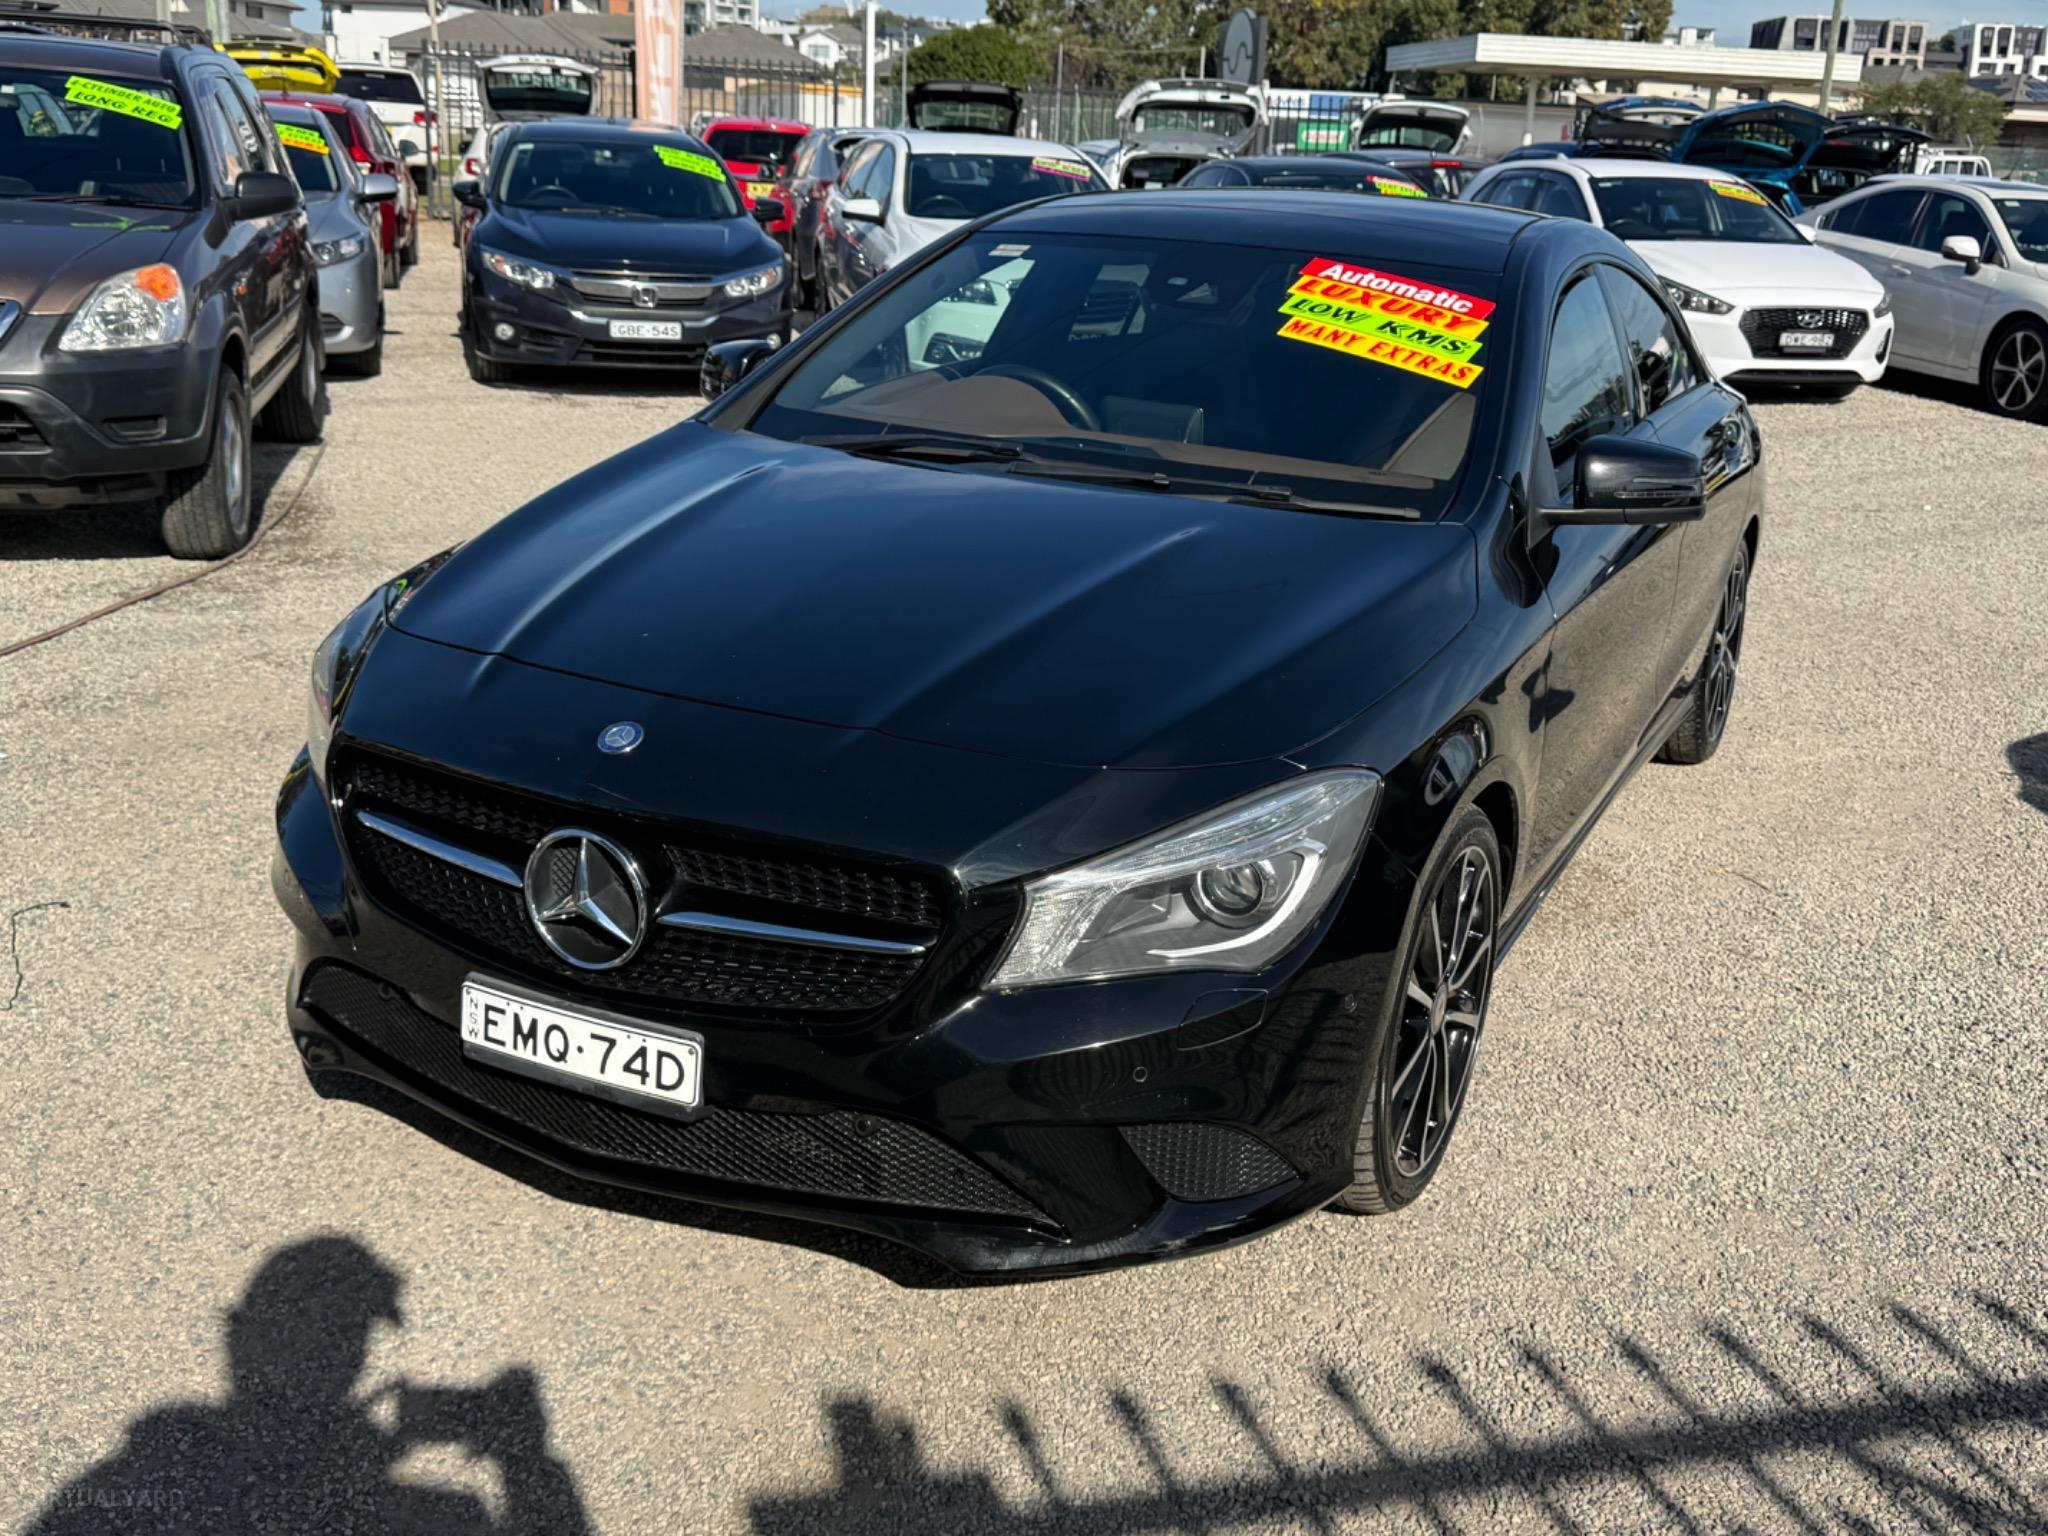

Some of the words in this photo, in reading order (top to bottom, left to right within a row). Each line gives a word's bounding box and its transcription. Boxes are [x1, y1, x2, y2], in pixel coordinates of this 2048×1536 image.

[74, 91, 126, 109] LONG
[132, 105, 173, 123] REG
[143, 97, 176, 112] AUTO
[1295, 279, 1480, 332] LUXURY
[1318, 264, 1473, 314] Automatic
[1283, 319, 1361, 348] MANY
[1366, 341, 1474, 380] EXTRAS
[1290, 298, 1373, 324] LOW
[1375, 320, 1472, 356] KMS
